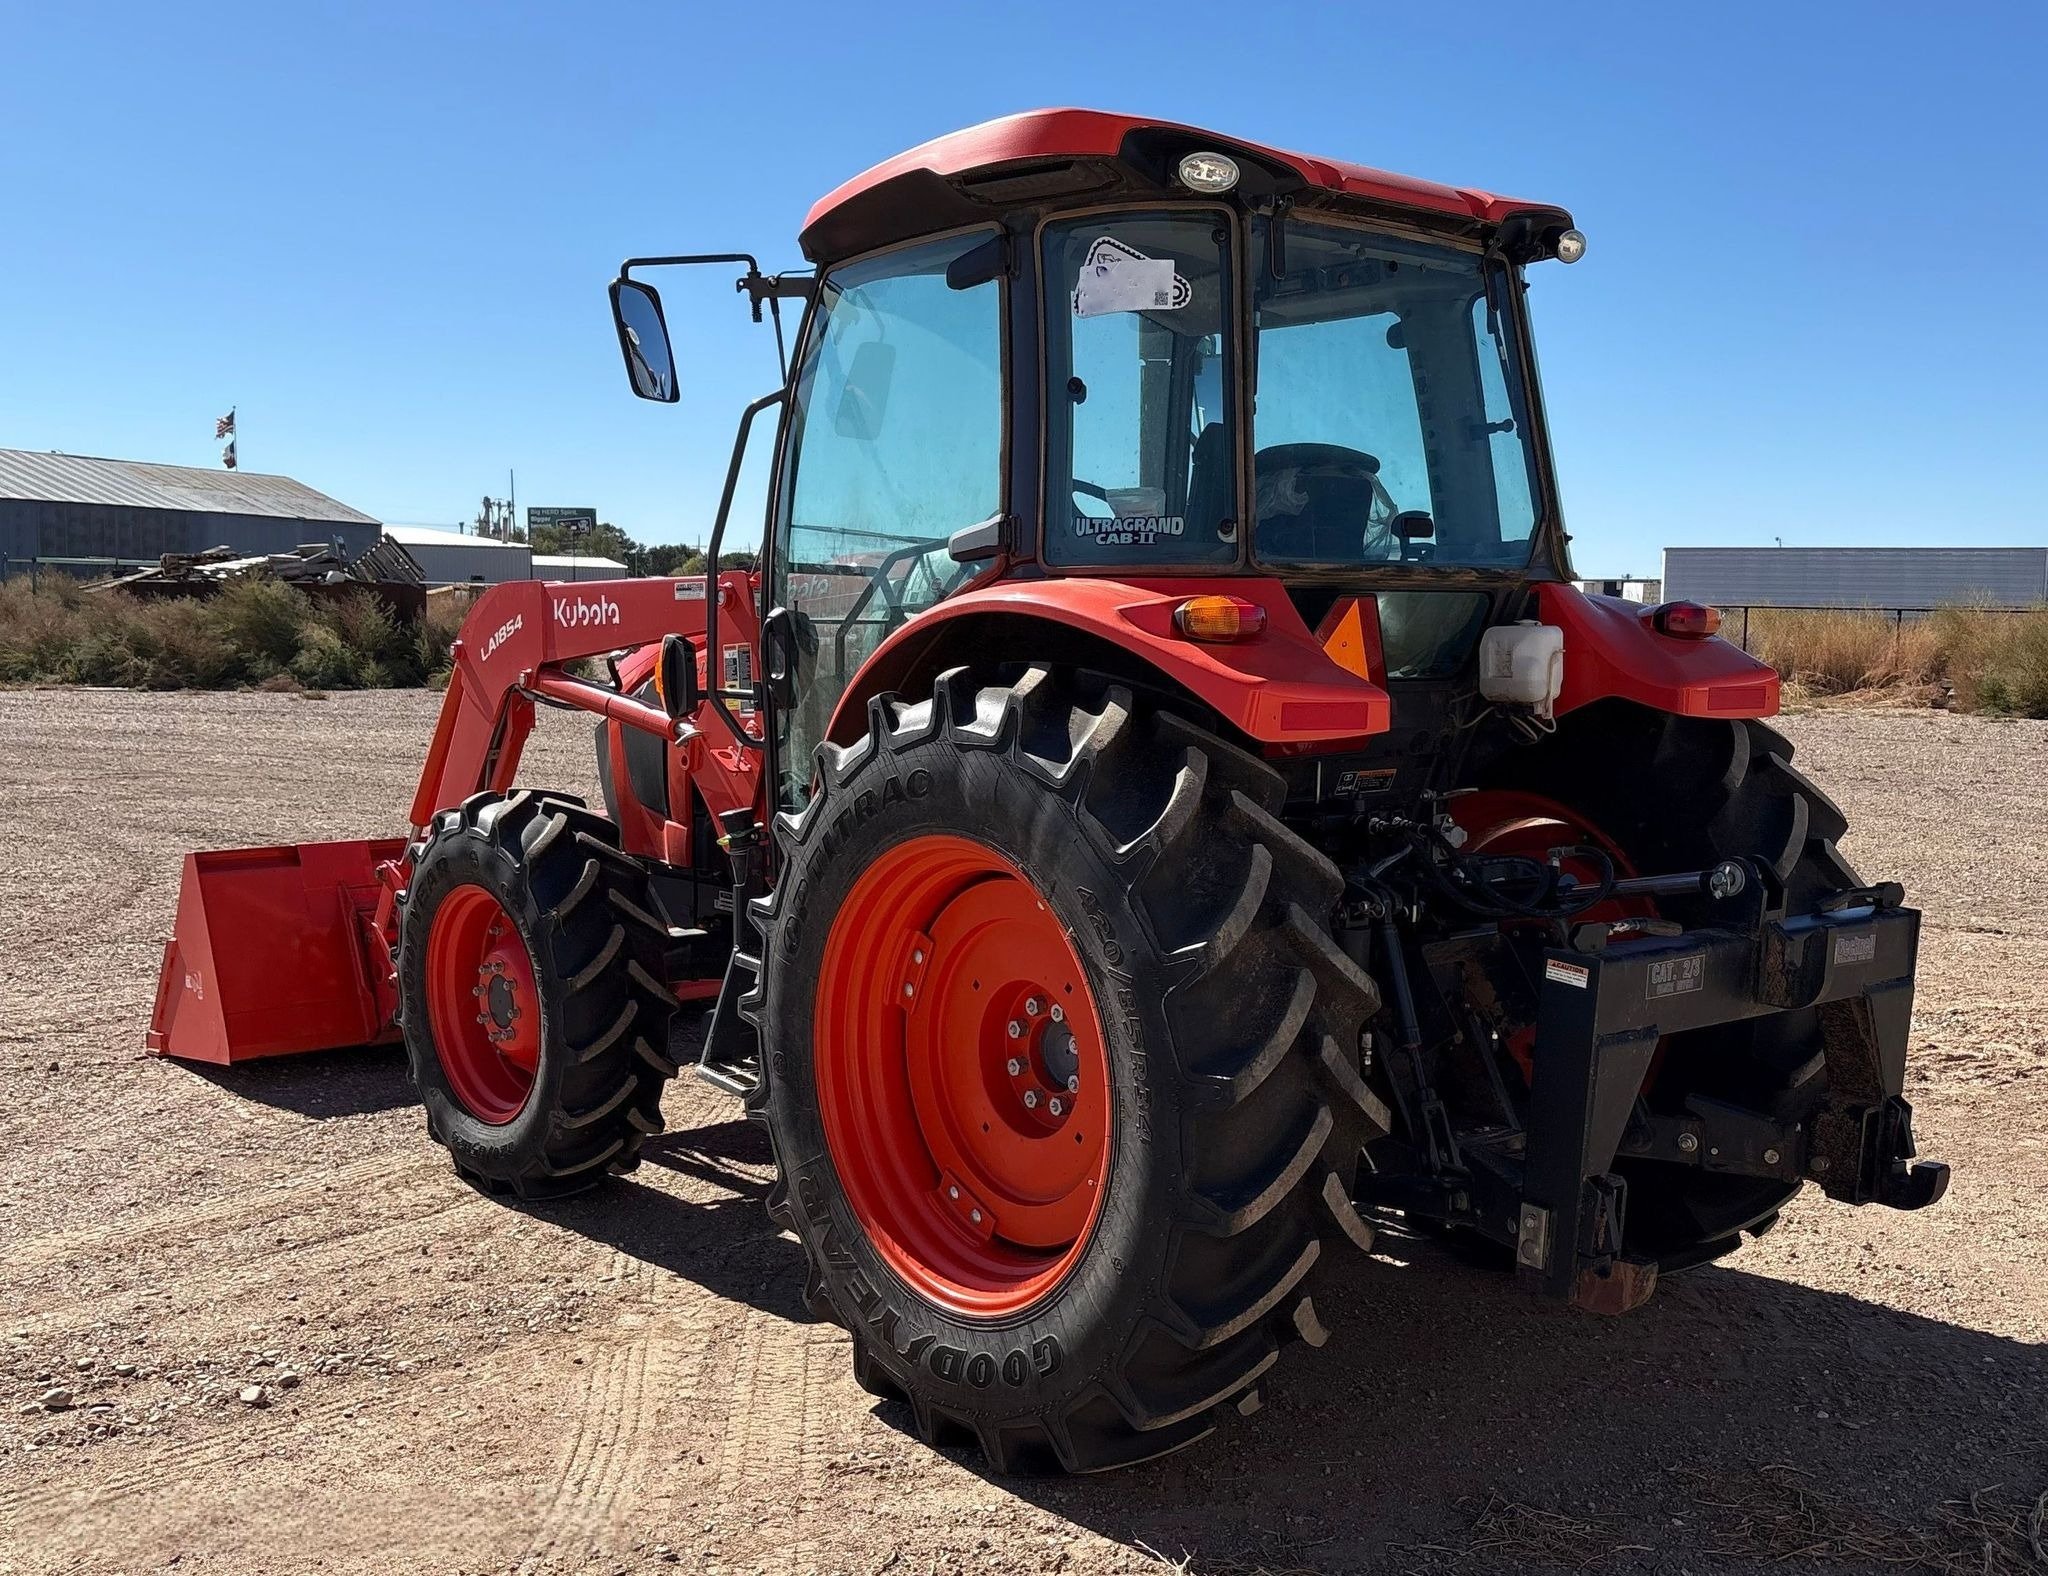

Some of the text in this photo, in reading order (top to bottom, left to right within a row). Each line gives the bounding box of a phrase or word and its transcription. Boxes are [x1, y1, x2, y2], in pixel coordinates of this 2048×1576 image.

[1075, 517, 1184, 536] ULTRAGRAND
[1095, 532, 1155, 545] CAB-II
[553, 594, 620, 628] Kubota
[480, 613, 523, 662] LA1854
[1556, 962, 1584, 975] CAUTION
[1651, 958, 1701, 984] CAT. 2/3
[799, 1176, 1064, 1390] GOODYEAR
